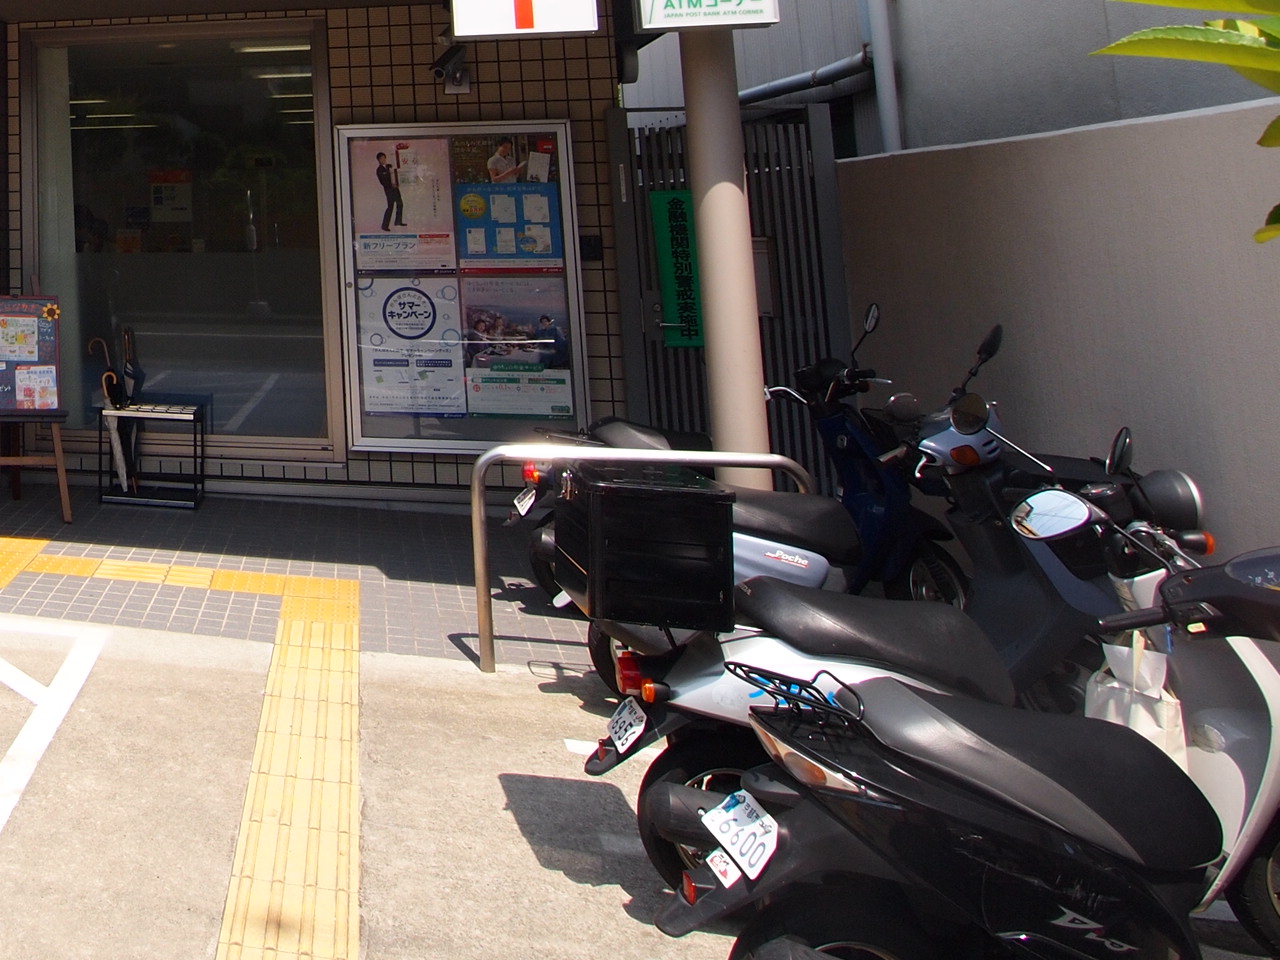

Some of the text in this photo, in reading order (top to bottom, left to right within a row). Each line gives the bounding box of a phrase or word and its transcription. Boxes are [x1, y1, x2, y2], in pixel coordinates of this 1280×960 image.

[738, 8, 764, 16] CORNER
[667, 196, 699, 341] 金融機関特別警戒実施中
[398, 301, 421, 311] サマー
[387, 310, 432, 320] キャンペーン
[718, 817, 766, 869] 6600
